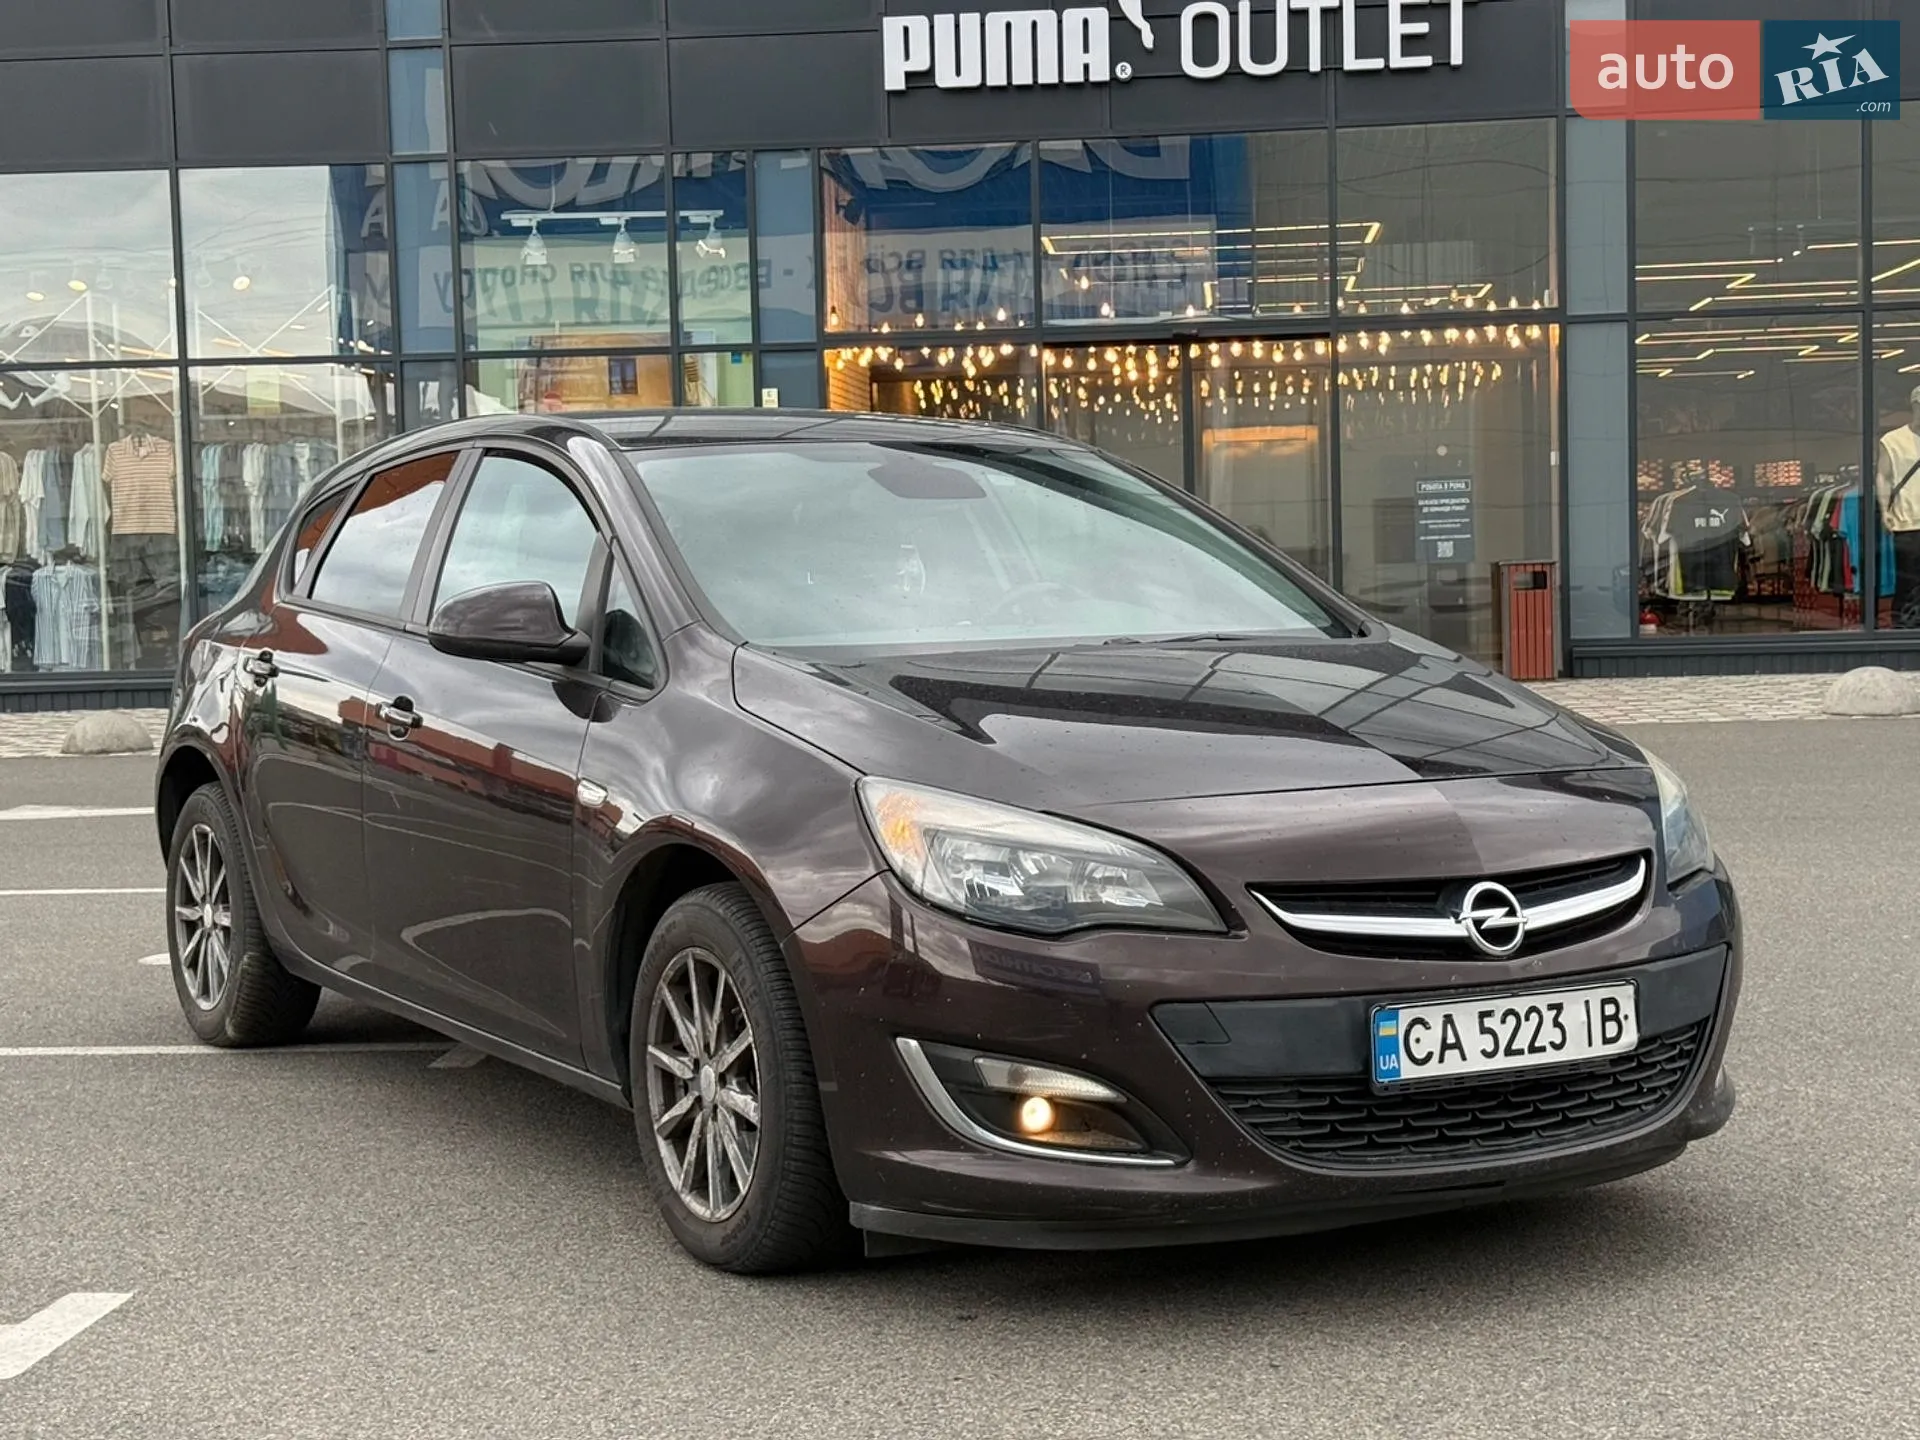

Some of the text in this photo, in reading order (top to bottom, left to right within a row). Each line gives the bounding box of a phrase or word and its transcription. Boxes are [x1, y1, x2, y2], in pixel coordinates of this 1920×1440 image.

[882, 7, 1110, 91] PUMA
[1180, 0, 1479, 78] OUTLET
[1379, 1054, 1399, 1071] UA
[1403, 996, 1624, 1067] CA 5223 IB
